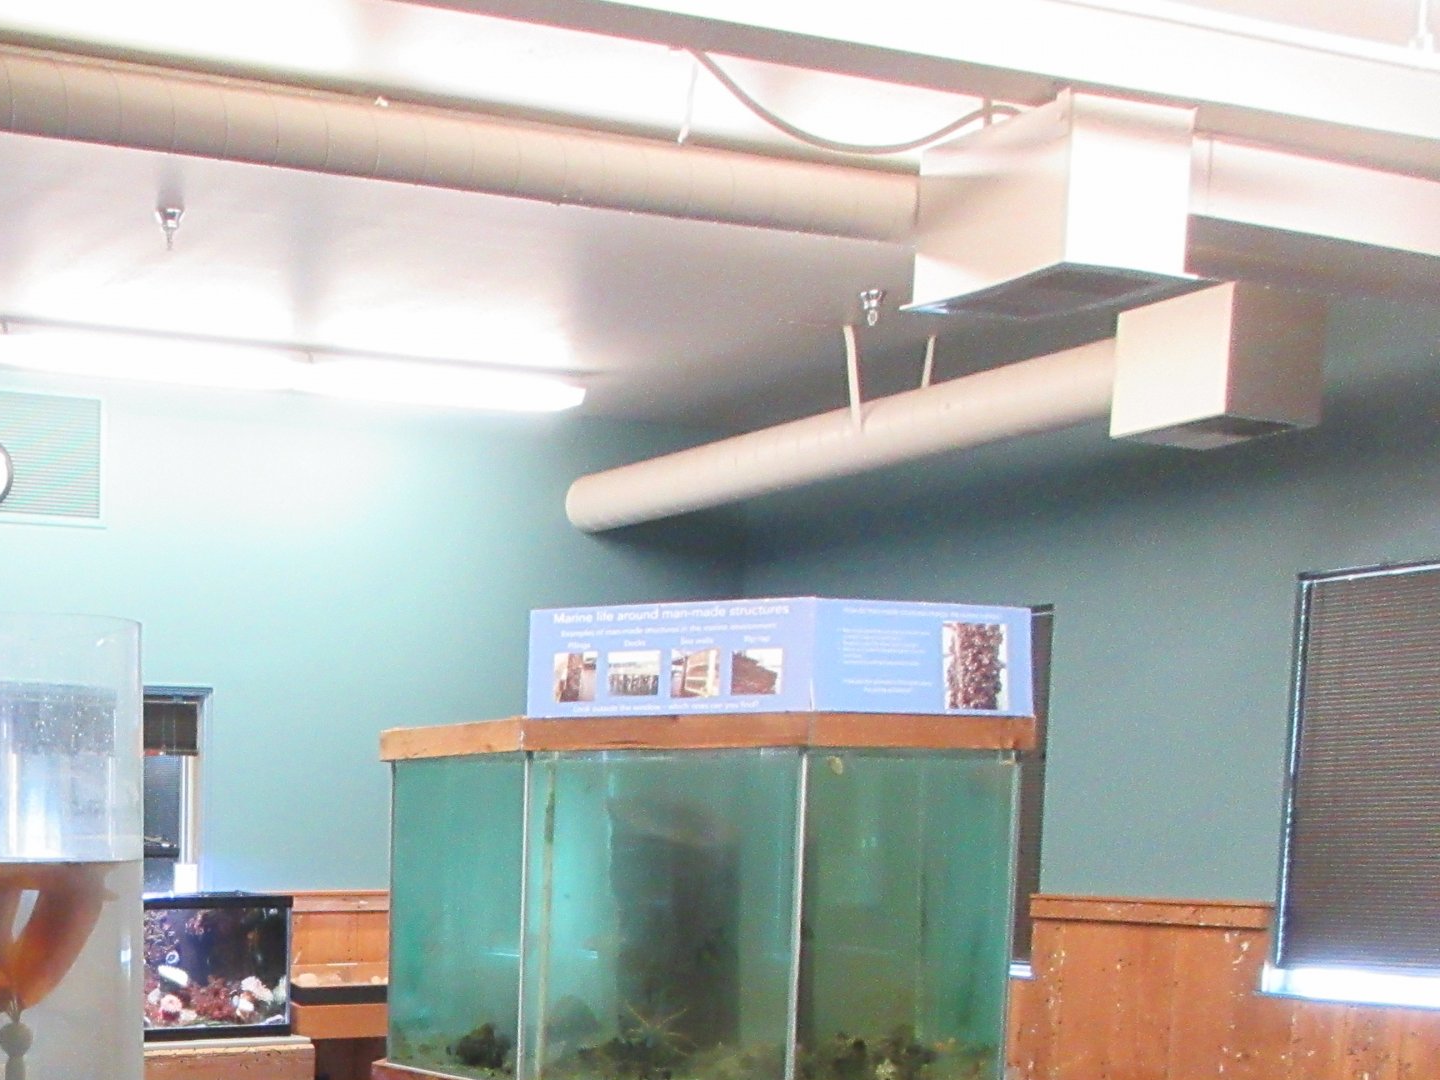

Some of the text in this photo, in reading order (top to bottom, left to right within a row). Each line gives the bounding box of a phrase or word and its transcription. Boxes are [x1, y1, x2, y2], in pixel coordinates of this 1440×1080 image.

[553, 604, 790, 624] Marine life around man-made structures
